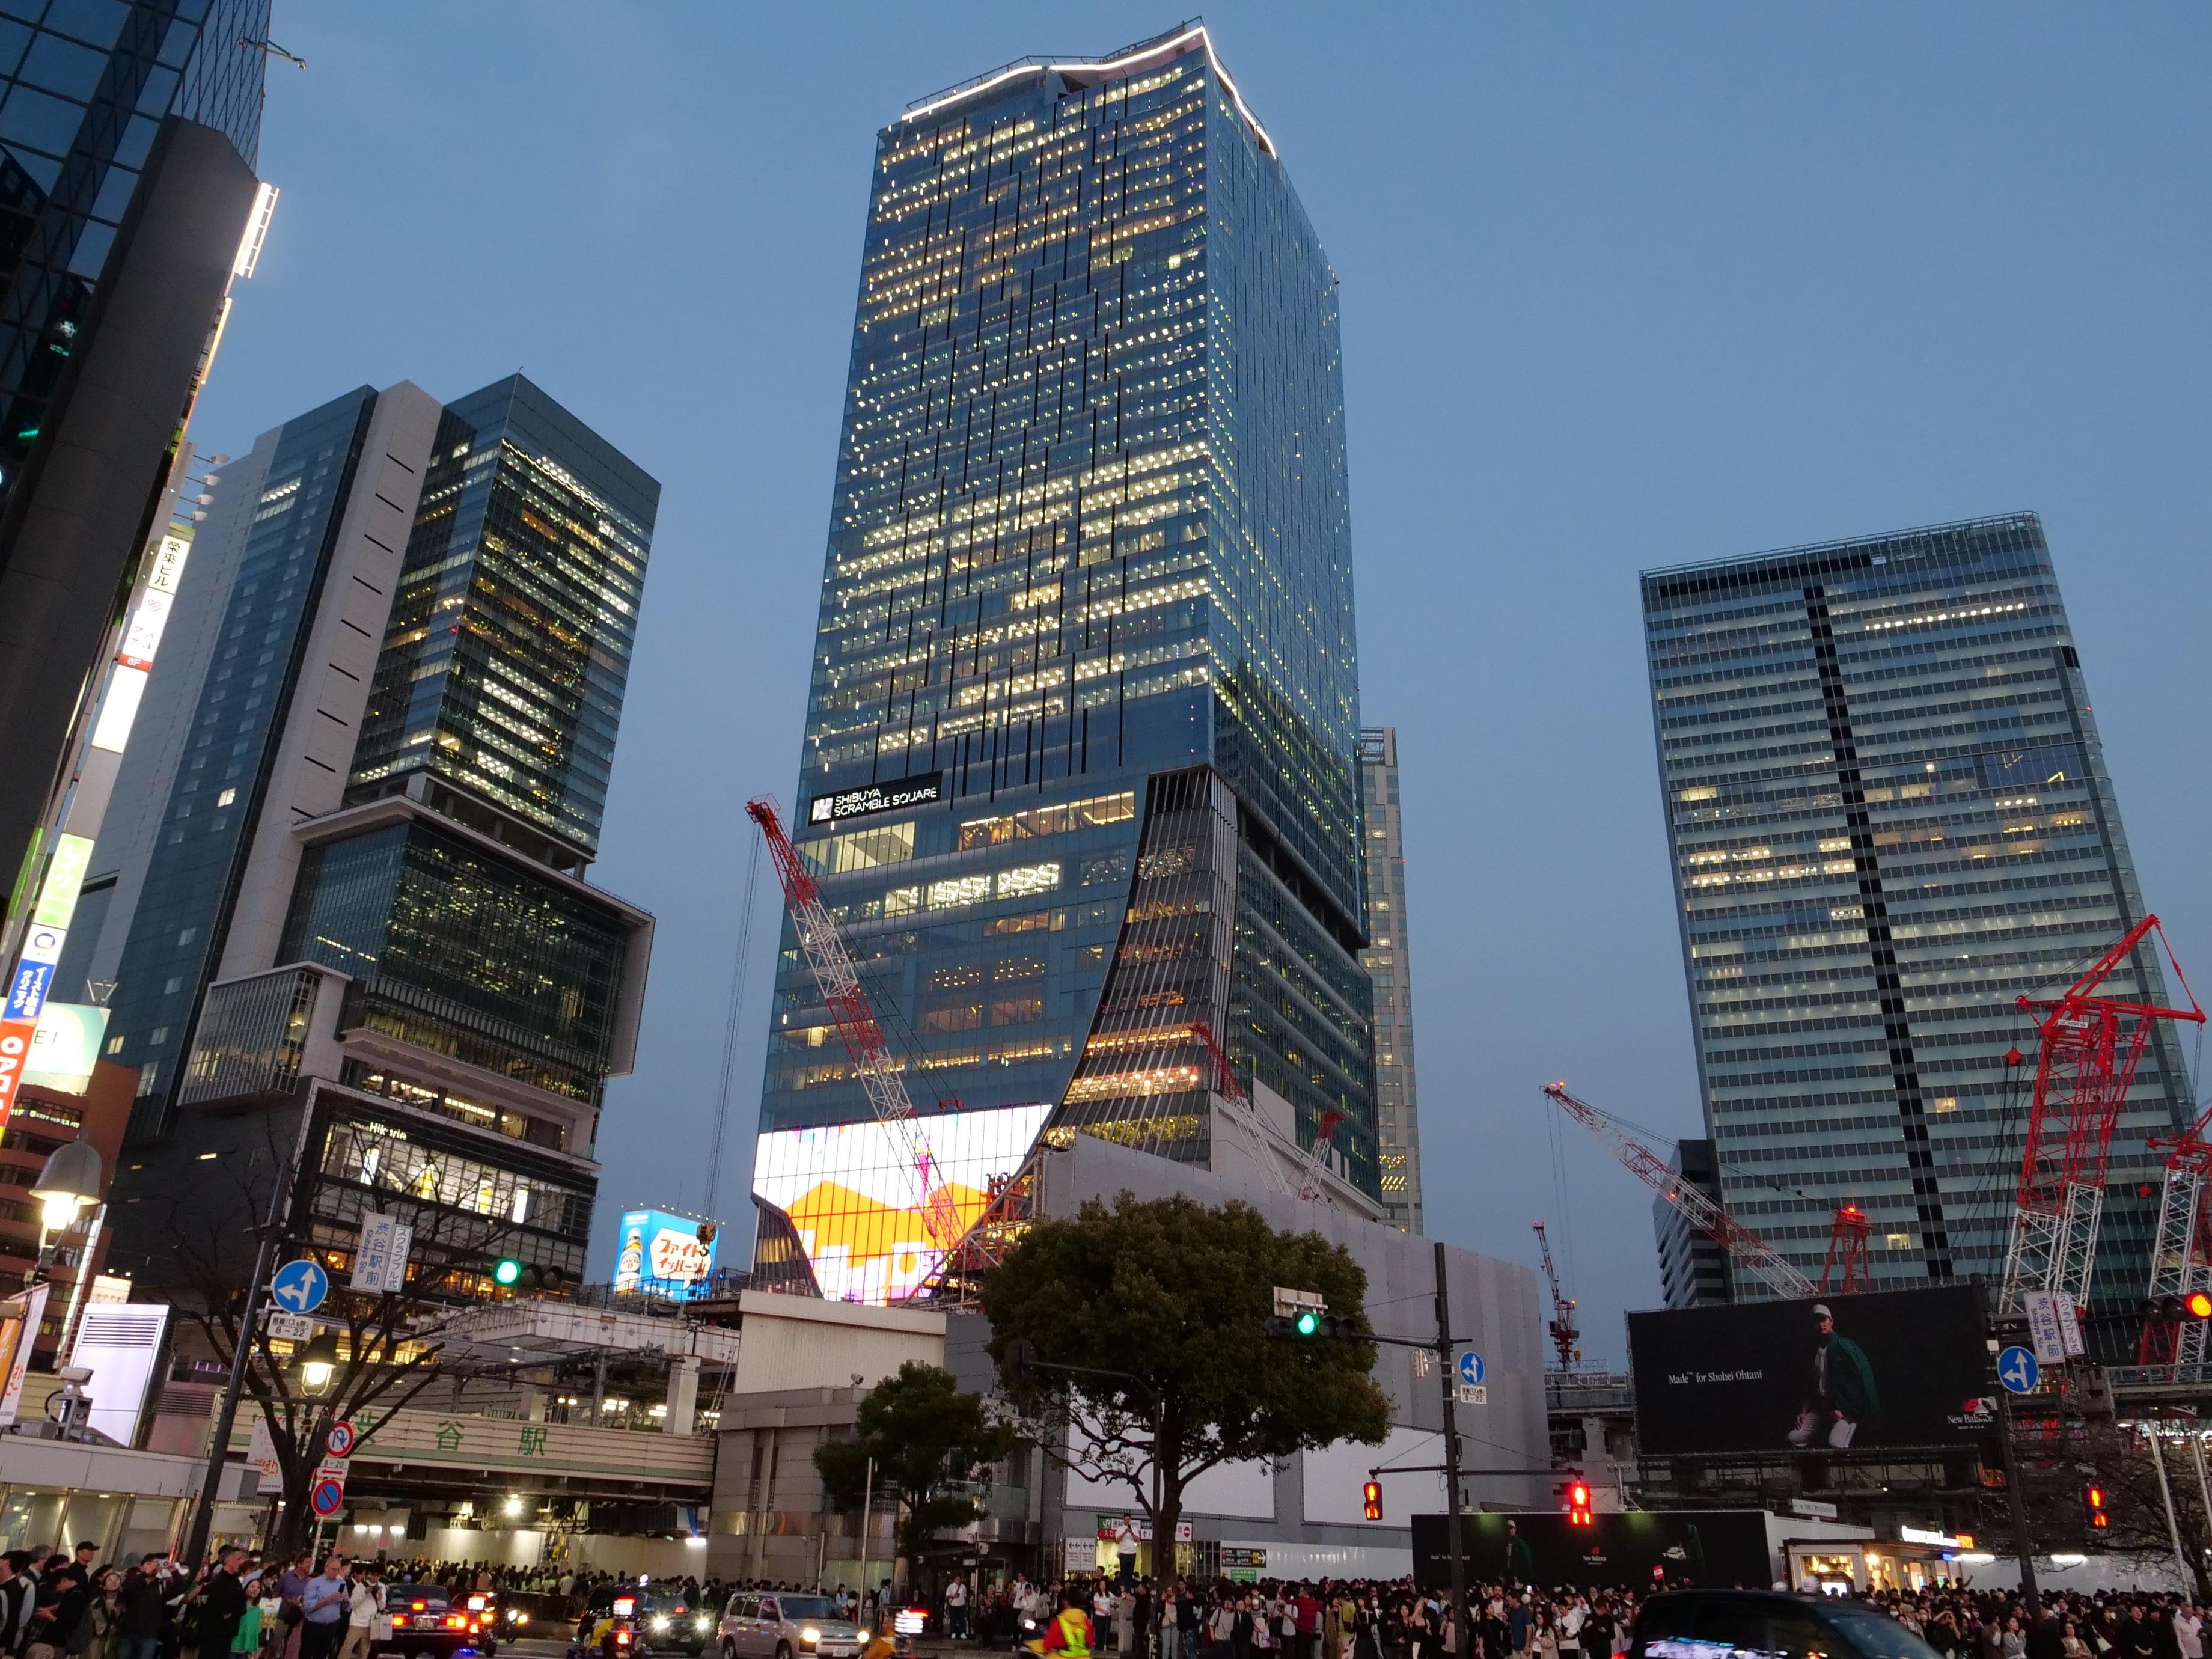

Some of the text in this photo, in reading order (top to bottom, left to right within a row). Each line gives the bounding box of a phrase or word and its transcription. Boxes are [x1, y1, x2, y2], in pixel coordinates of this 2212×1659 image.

[127, 656, 142, 667] 8F
[834, 788, 881, 807] SHIBUYA
[834, 787, 937, 817] SCRAMBLE SQUARE
[365, 1221, 389, 1285] 渋谷駅前
[388, 1228, 407, 1288] スクランブル式
[660, 1238, 701, 1258] ファイト
[2037, 1297, 2059, 1357] 渋谷駅前
[2059, 1295, 2080, 1352] スクランブル式
[1696, 1372, 1707, 1383] for
[1708, 1370, 1734, 1382] Shohei
[1735, 1370, 1762, 1381] Ohtani
[1947, 1414, 1964, 1424] New
